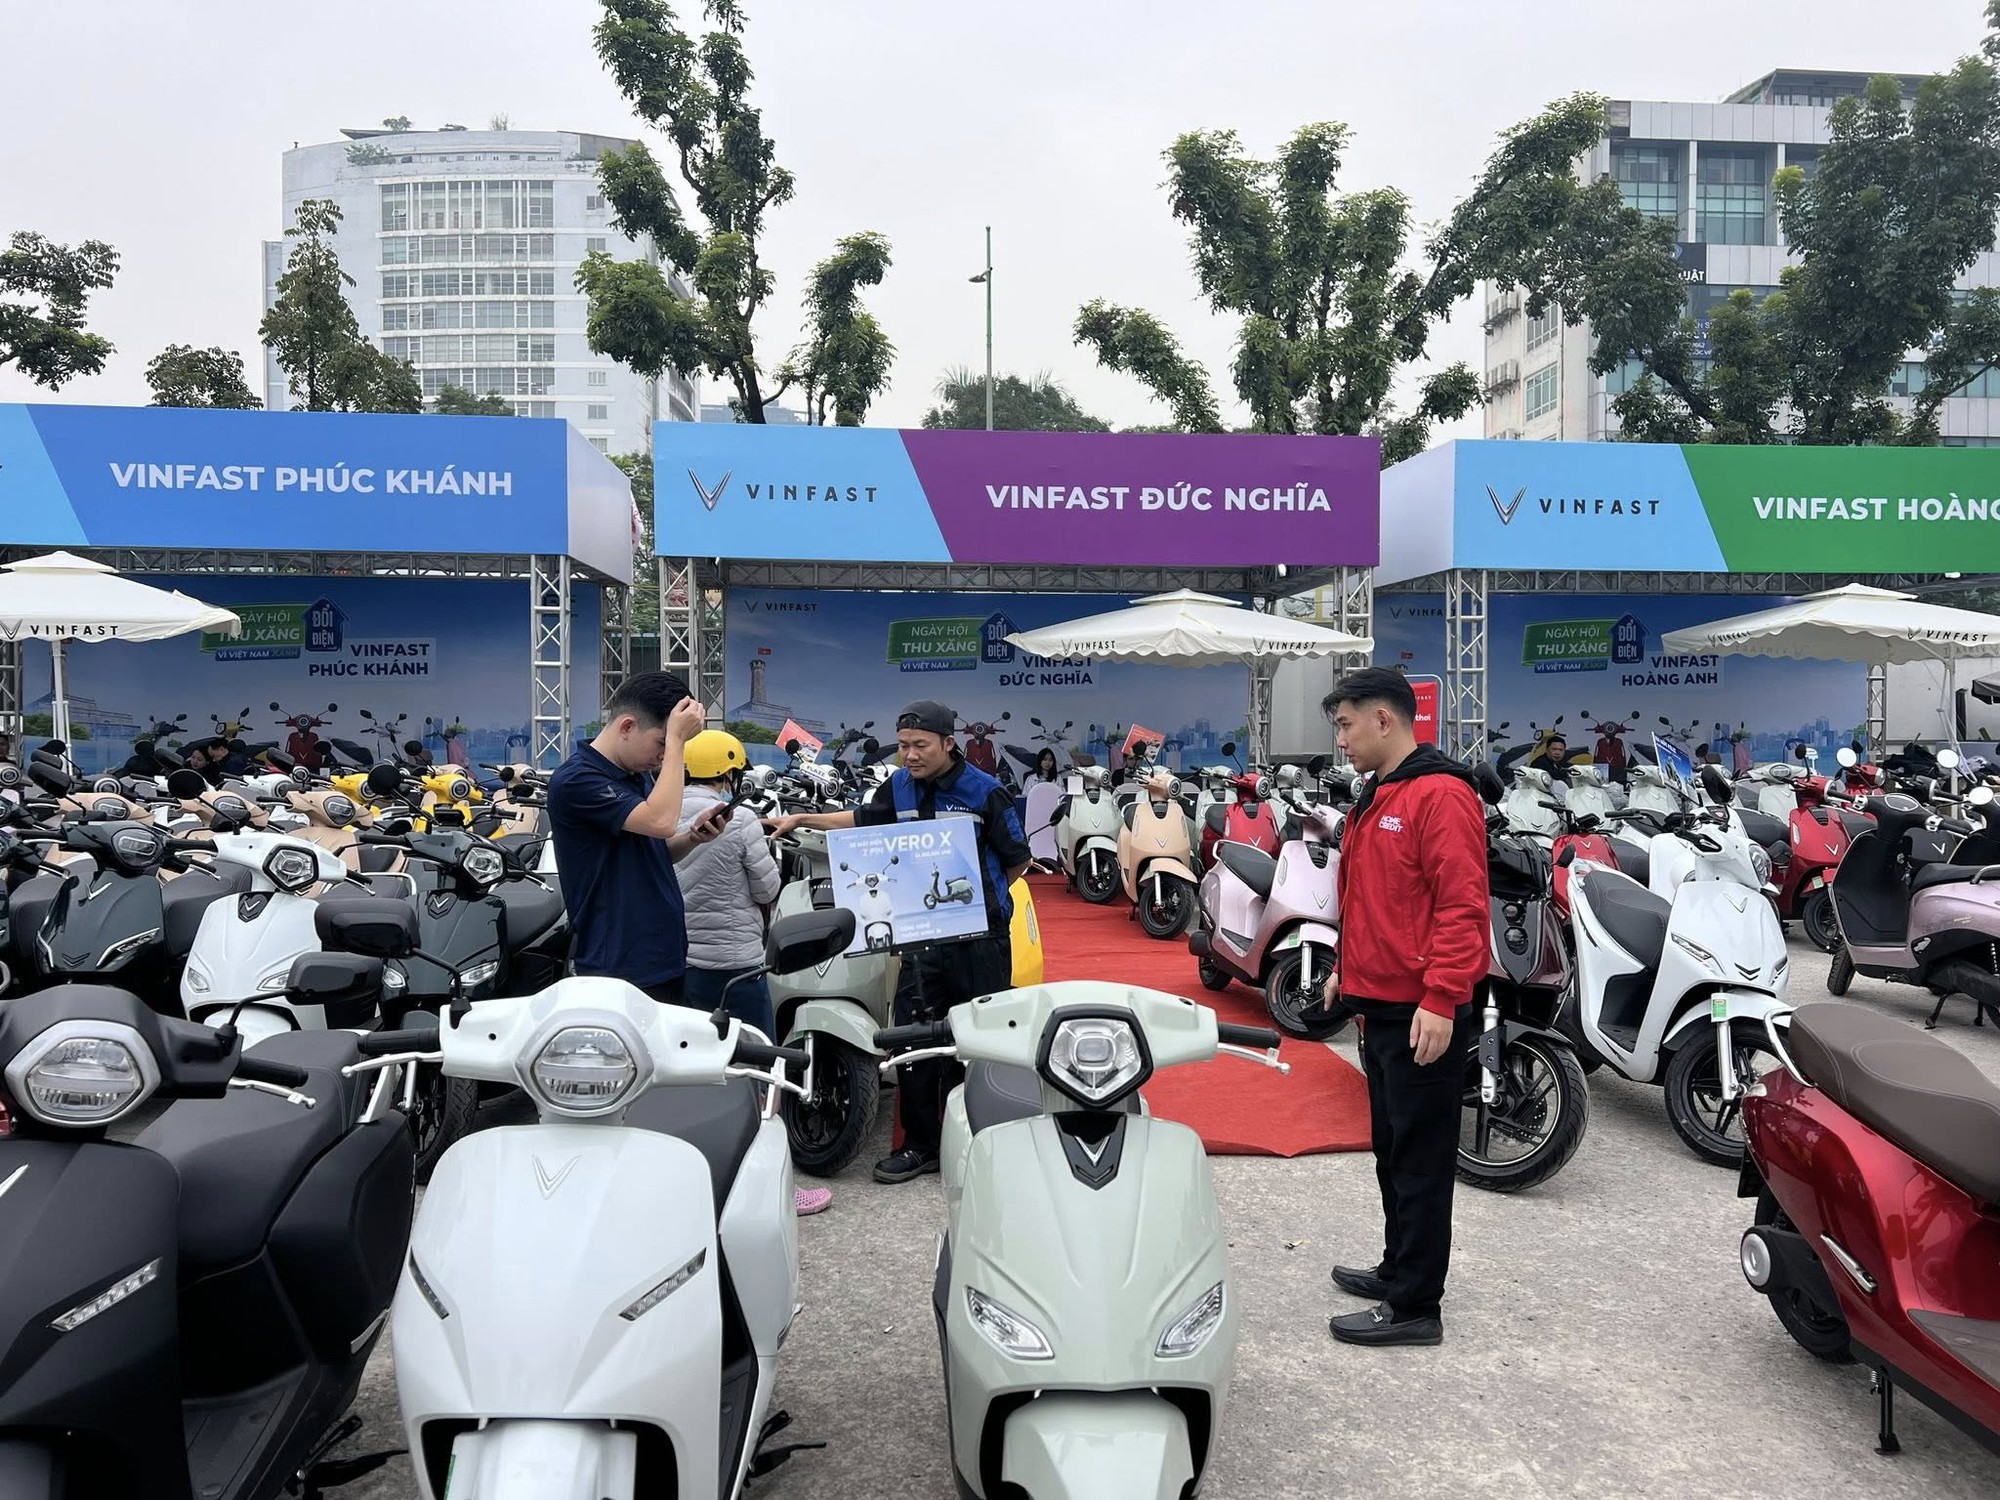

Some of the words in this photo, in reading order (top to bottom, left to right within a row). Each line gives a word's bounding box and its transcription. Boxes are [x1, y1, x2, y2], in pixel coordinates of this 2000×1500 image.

[109, 463, 265, 491] VINFAST
[275, 462, 375, 494] PHÚC
[386, 464, 512, 496] KHÁNH
[746, 484, 877, 502] VINFAST
[985, 485, 1130, 510] VINFAST
[1140, 481, 1213, 511] ĐỨC
[1224, 482, 1332, 511] NGHĨA
[1539, 499, 1659, 515] VINFAST
[1752, 496, 1888, 520] VINFAST
[765, 603, 819, 611] VINFAST
[1409, 608, 1456, 616] VINFAT
[240, 610, 264, 623] GÀY
[267, 609, 291, 624] HỘI
[312, 603, 333, 627] ĐỔI
[30, 625, 119, 635] VINFAST
[255, 625, 300, 641] XĂNG
[911, 624, 944, 637] NGÀY
[947, 623, 968, 638] HỘI
[1545, 626, 1577, 639] NGÀY
[1580, 625, 1600, 639] HỘI
[1618, 619, 1636, 641] ĐỔI
[1926, 630, 1988, 642] VINFAST
[312, 629, 334, 648] ĐIỆN
[902, 641, 932, 654] THU
[935, 638, 977, 653] XĂNG
[1074, 640, 1116, 651] VINFAST
[1268, 641, 1317, 650] VINFAST
[229, 649, 249, 660] VIỆT
[250, 650, 270, 658] NAM
[350, 643, 430, 657] VINFAST
[988, 642, 1008, 659] ĐIỆN
[1537, 643, 1565, 655] THU
[1568, 640, 1608, 654] XĂNG
[1618, 643, 1637, 660] ĐIỆN
[309, 660, 358, 677] PHÚC
[364, 659, 429, 676] KHÁNH
[1651, 655, 1719, 668] VINFAST
[999, 670, 1035, 686] ĐỨC
[1041, 670, 1093, 686] NGHĨA
[1622, 671, 1680, 686] HOÀNG
[1685, 673, 1718, 685] ANH
[1379, 820, 1404, 832] CREDIT
[1381, 815, 1402, 824] HOME
[884, 833, 934, 853] VERO
[939, 831, 952, 847] X
